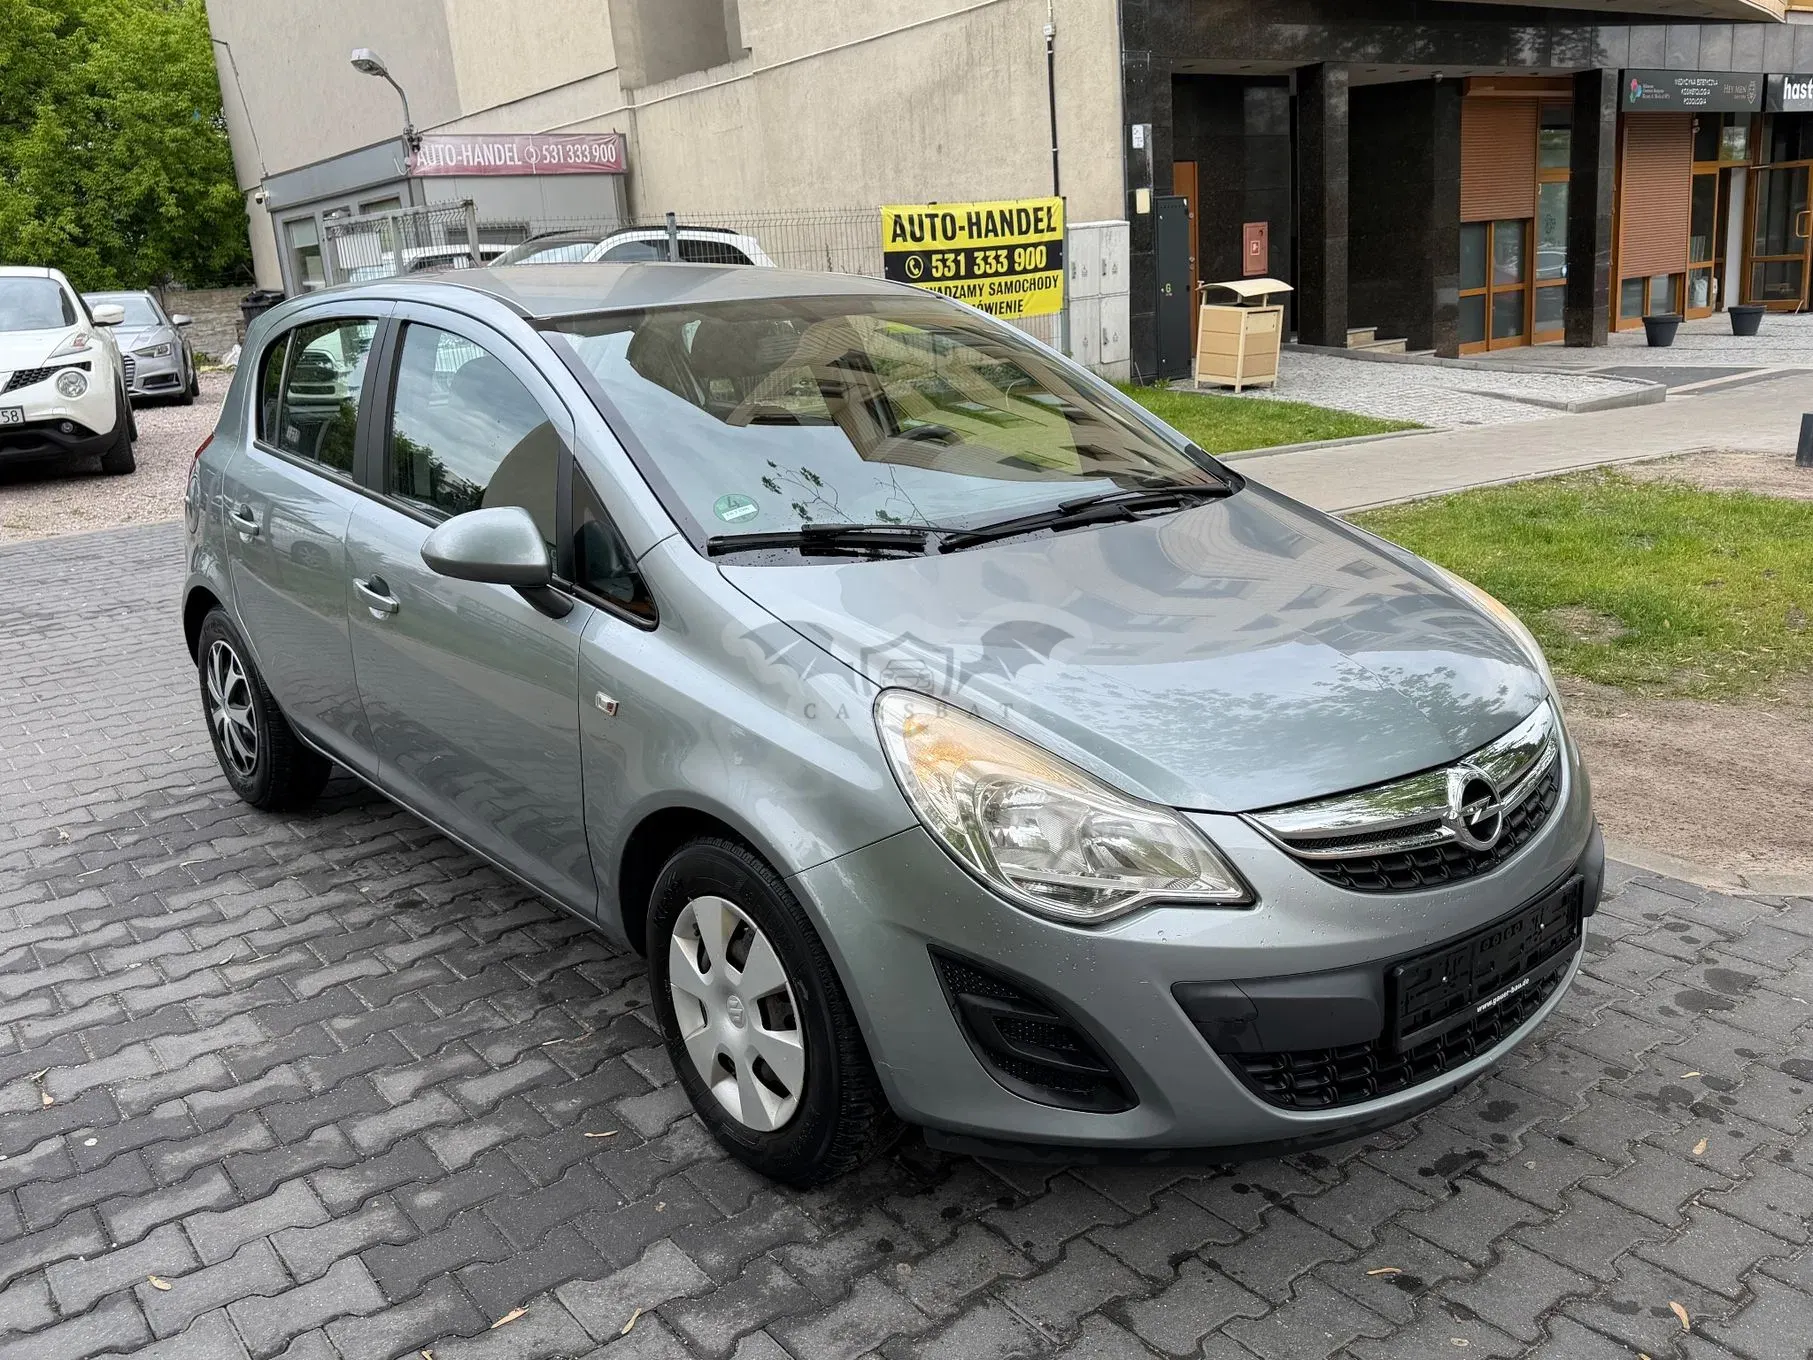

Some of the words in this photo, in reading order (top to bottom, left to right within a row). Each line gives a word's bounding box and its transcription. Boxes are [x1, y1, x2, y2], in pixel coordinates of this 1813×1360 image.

[417, 143, 522, 166] AUTO-HANDEL
[543, 144, 564, 164] 531
[566, 144, 590, 163] 333
[592, 143, 616, 163] 900
[891, 205, 1057, 243] AUTO-HANDEL
[931, 252, 966, 278] 531
[973, 249, 1009, 275] 333
[1014, 245, 1047, 272] 900
[988, 275, 1059, 296] SAMOCHODY
[972, 299, 1024, 315] ÓWIENIE
